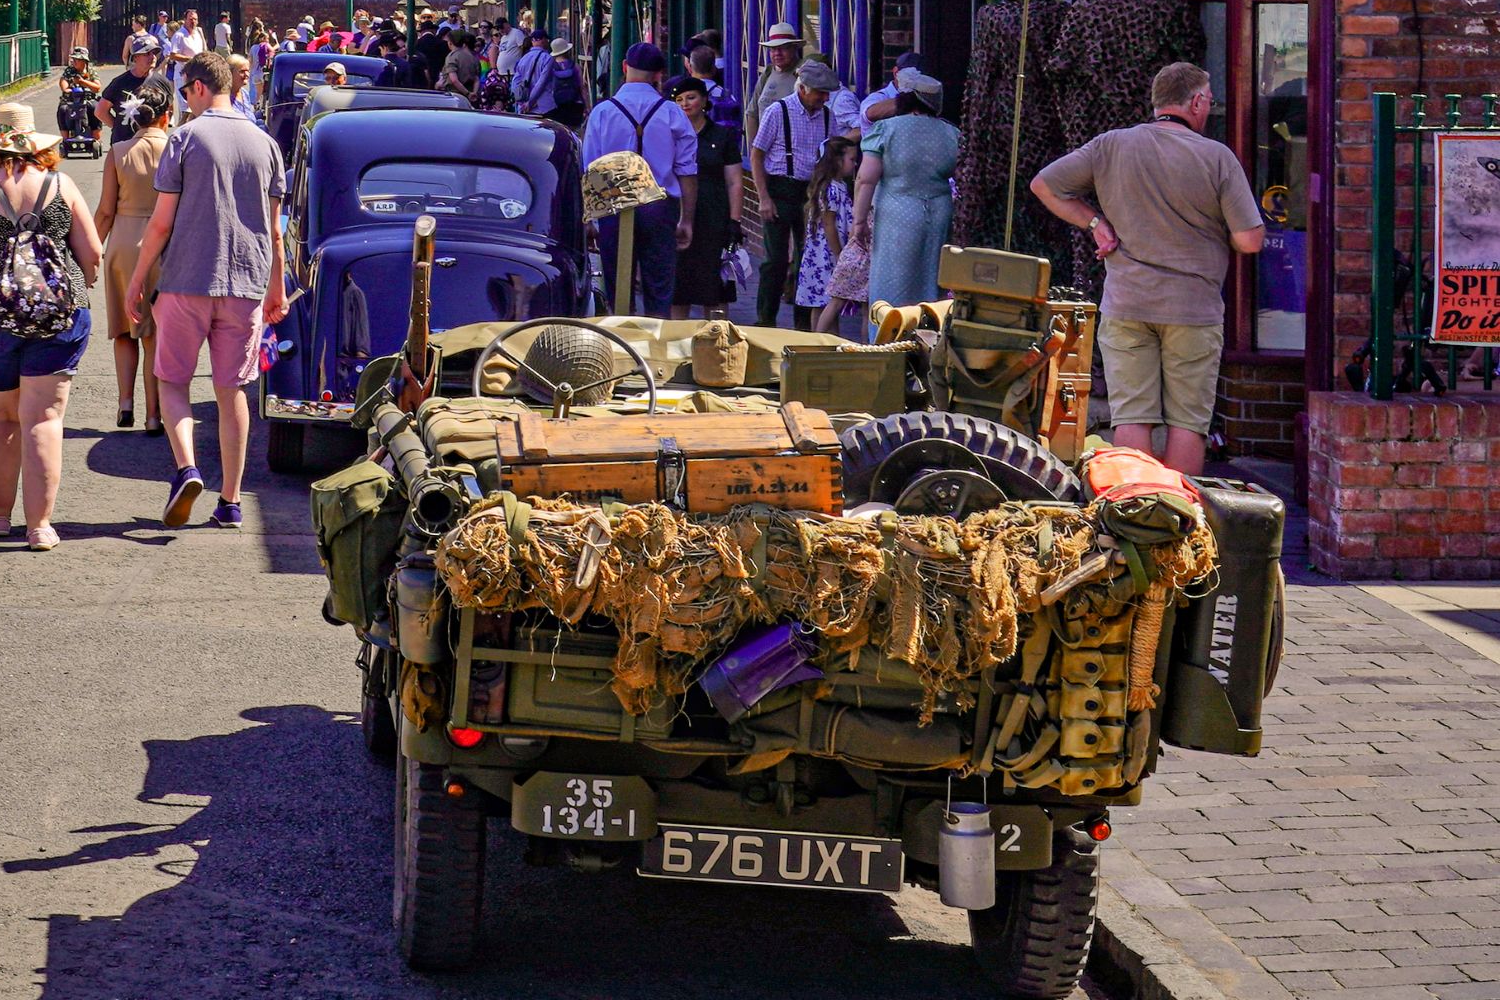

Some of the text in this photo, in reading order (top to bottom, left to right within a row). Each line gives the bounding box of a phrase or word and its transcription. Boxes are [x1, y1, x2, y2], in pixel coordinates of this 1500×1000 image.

[1445, 261, 1475, 273] Support
[1476, 262, 1490, 272] the
[1440, 310, 1476, 330] Do
[1208, 593, 1239, 685] WATER
[566, 778, 614, 807] 35
[999, 822, 1022, 852] 2
[661, 830, 882, 885] 676 UXT
